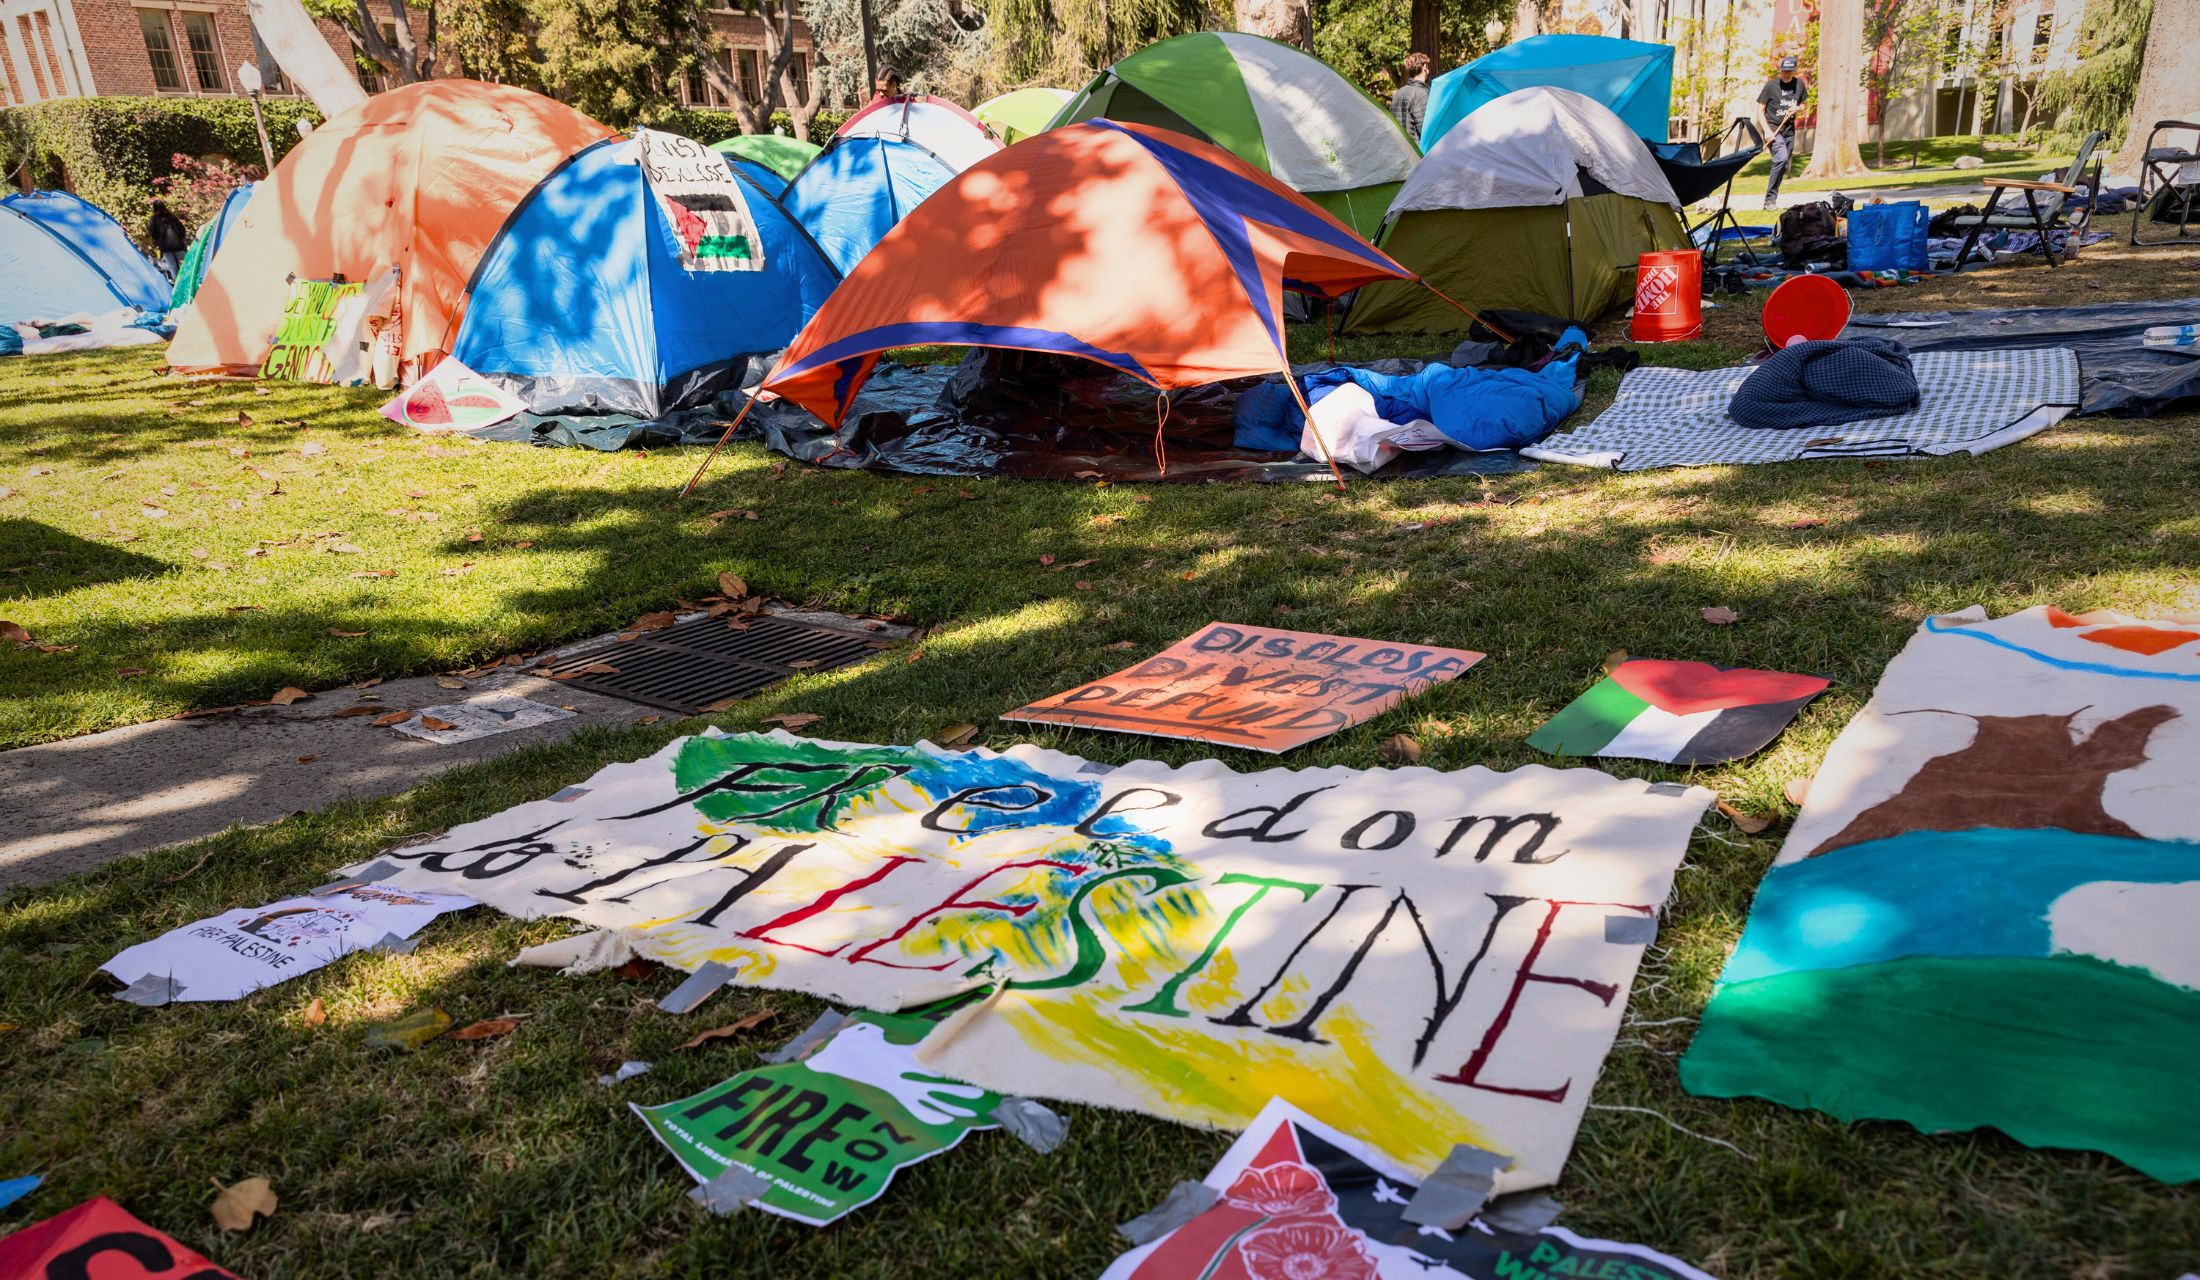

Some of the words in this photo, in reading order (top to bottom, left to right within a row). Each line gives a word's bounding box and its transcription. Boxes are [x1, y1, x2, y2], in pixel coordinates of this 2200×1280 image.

[1650, 289, 1672, 310] THE
[1126, 656, 1405, 706] DIVEST
[1191, 625, 1466, 682] DISCLOSE
[187, 926, 228, 939] FREE
[215, 933, 296, 969] PALESTINE
[533, 830, 1655, 1104] PALESTINE
[681, 1075, 872, 1173] FIRE
[663, 1118, 694, 1145] TOTAL
[756, 1169, 775, 1181] OF
[772, 1177, 838, 1208] PALESTINE
